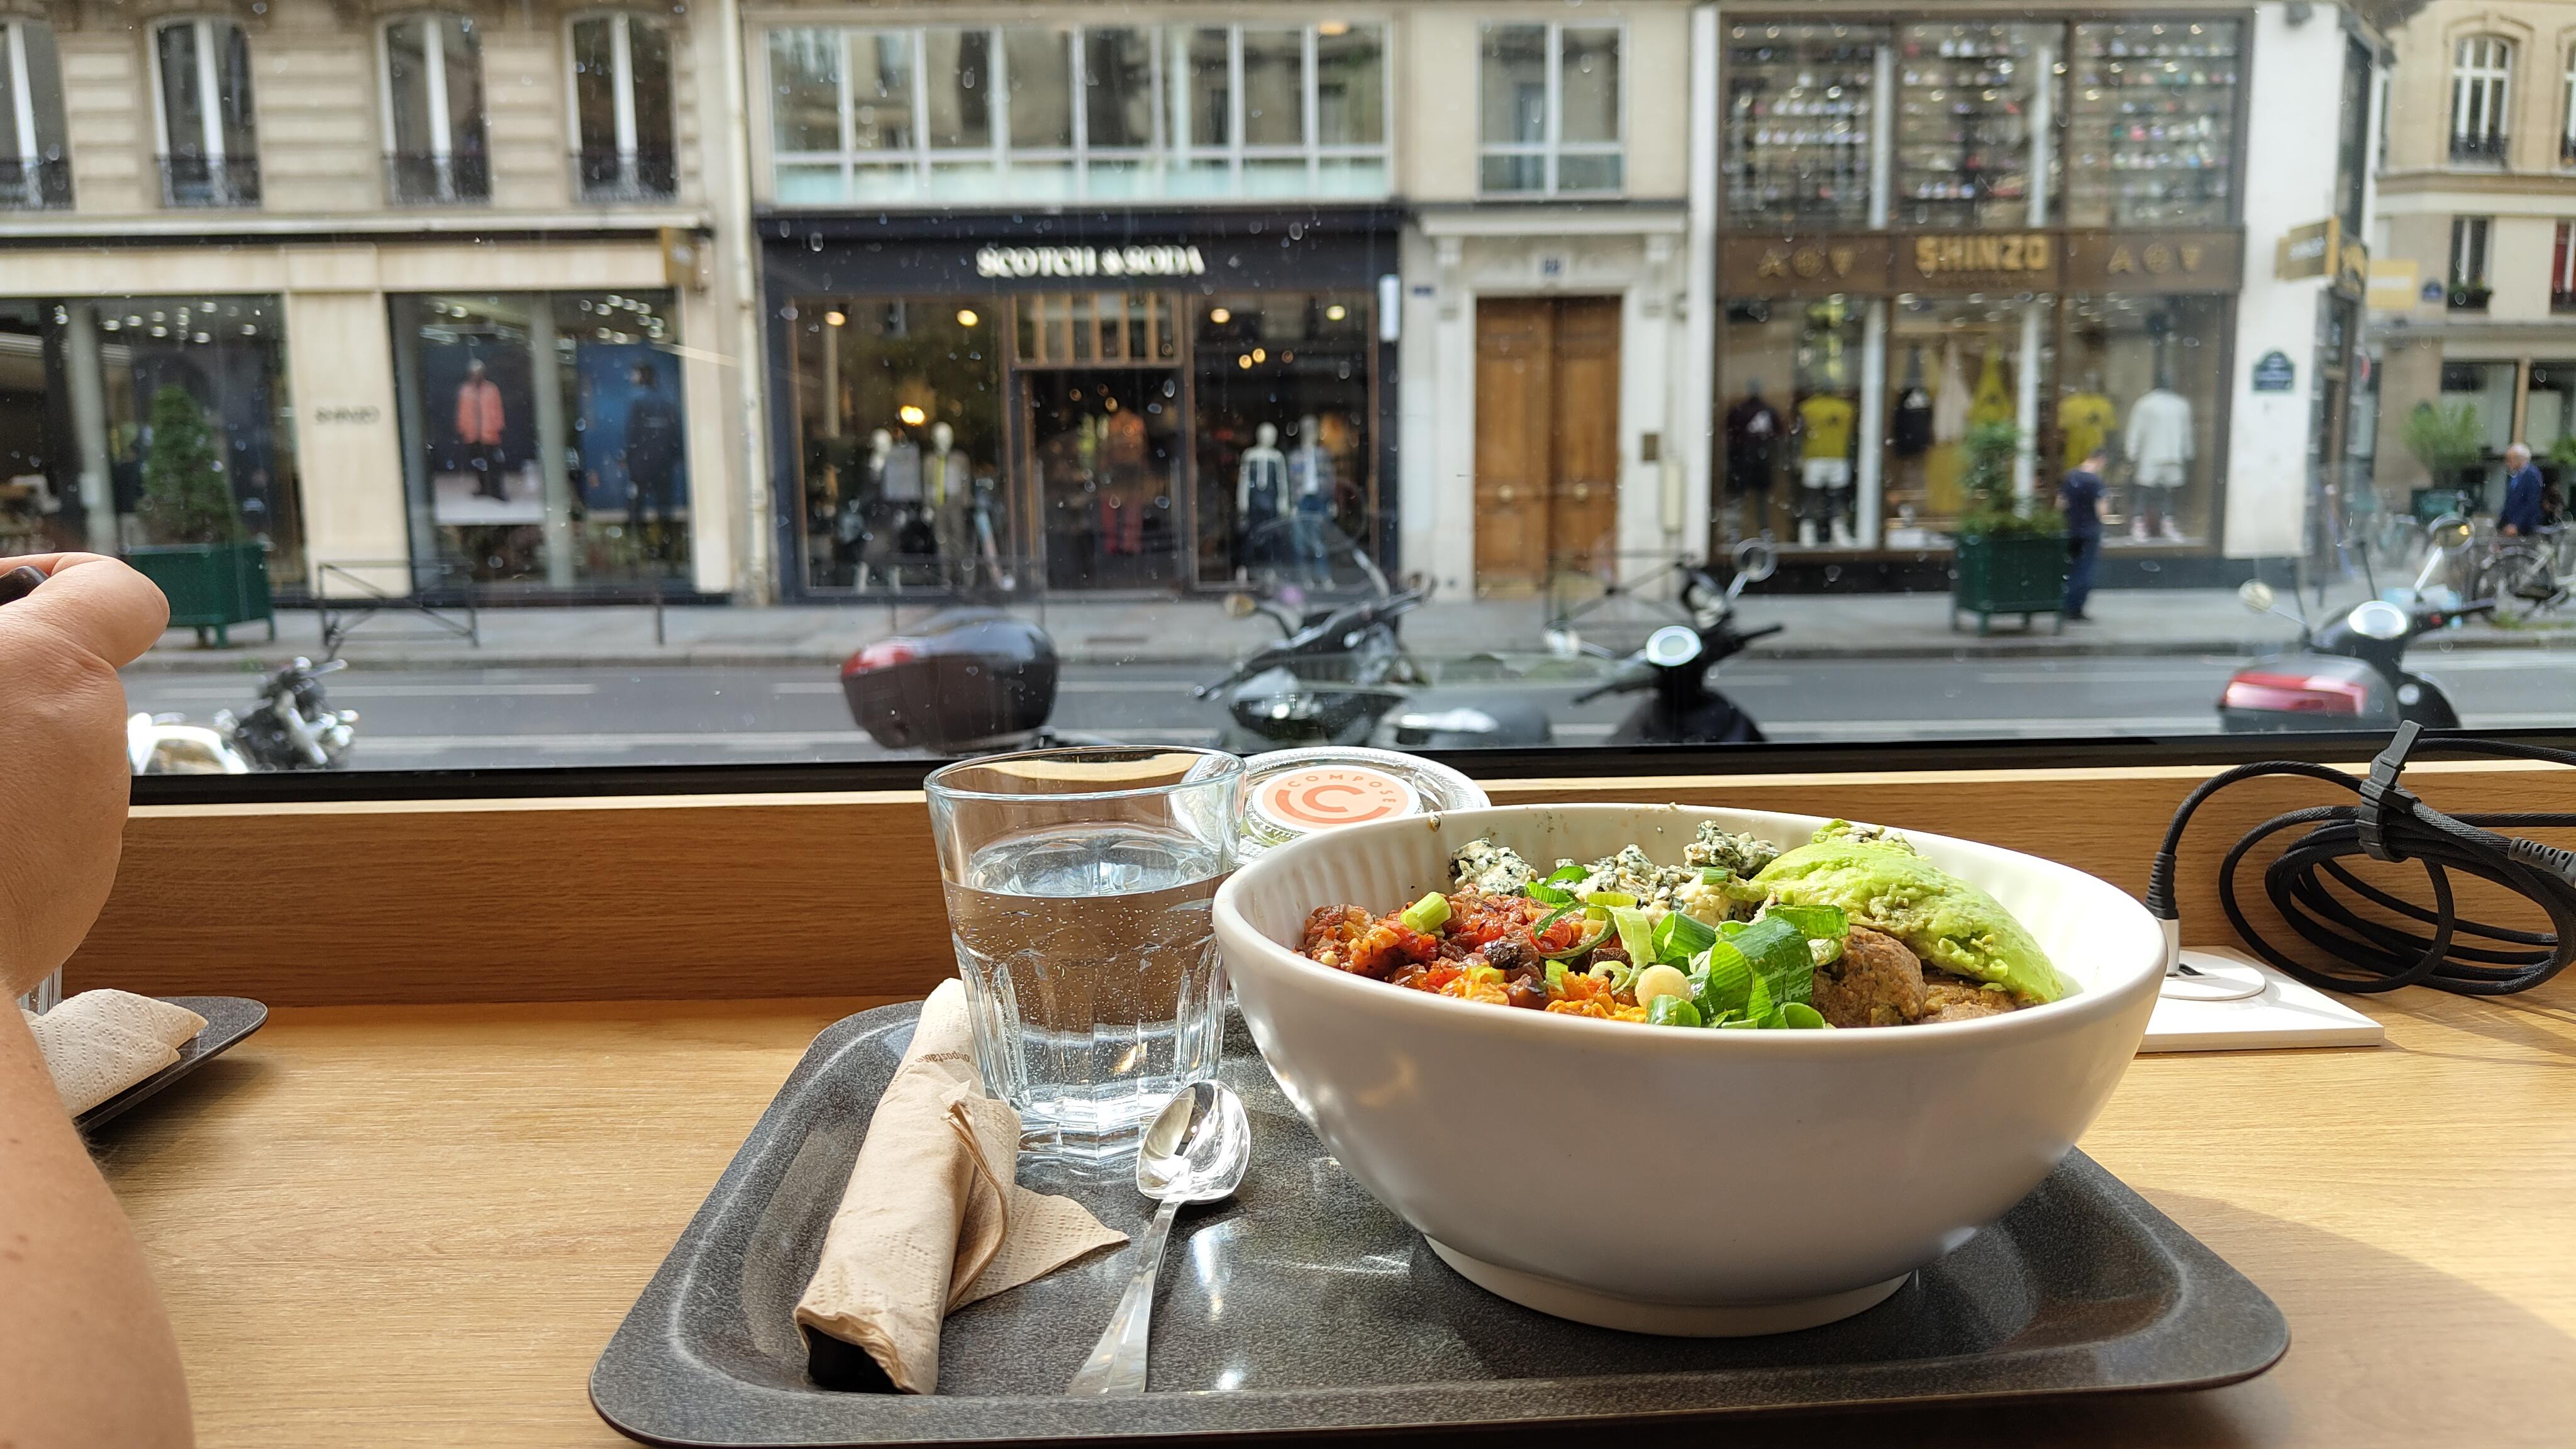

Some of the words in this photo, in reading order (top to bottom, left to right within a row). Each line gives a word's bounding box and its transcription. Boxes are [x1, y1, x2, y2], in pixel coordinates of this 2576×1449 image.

[976, 247, 1096, 277] SCOTCH
[1123, 245, 1205, 275] SODA
[1916, 235, 2049, 271] SHINZO
[1287, 773, 1396, 803] COMPOSE
